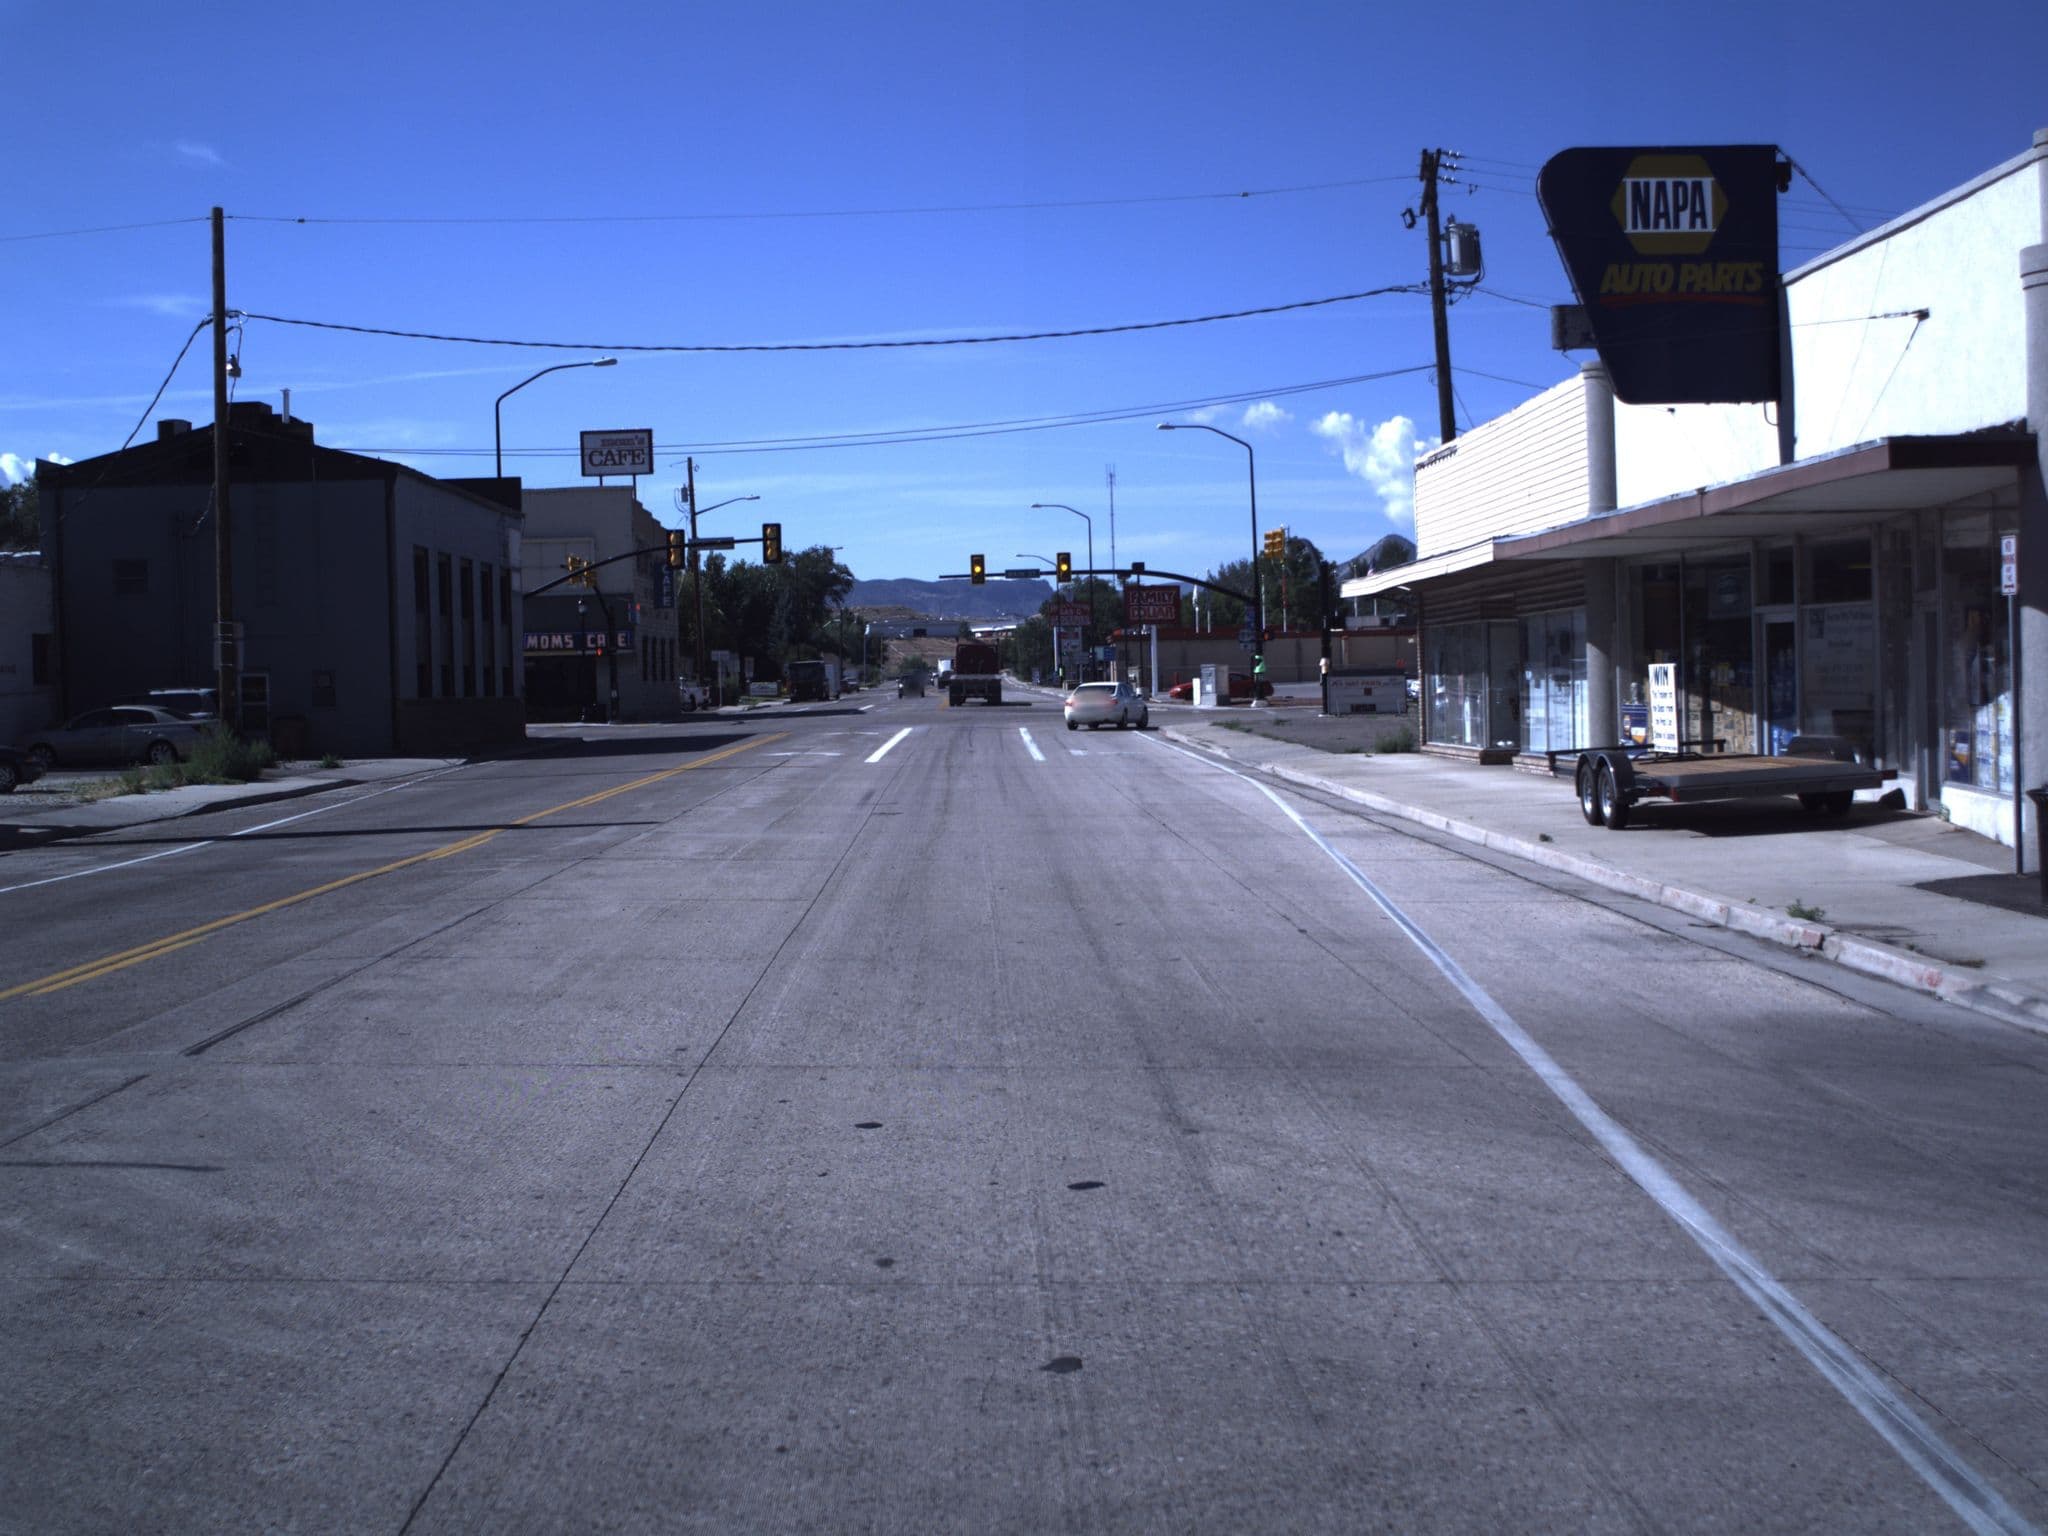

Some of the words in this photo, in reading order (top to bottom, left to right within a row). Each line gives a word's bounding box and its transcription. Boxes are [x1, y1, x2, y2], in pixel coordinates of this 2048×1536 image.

[1630, 180, 1708, 230] NAPA
[1600, 263, 1674, 294] AUTO
[1678, 262, 1765, 293] PARTS
[588, 448, 645, 467] CAFE
[1129, 590, 1176, 605] FAMILY
[1129, 604, 1176, 619] DOLLAR
[527, 634, 574, 649] MOMS
[586, 633, 627, 648] CAE
[1653, 665, 1669, 686] WIN
